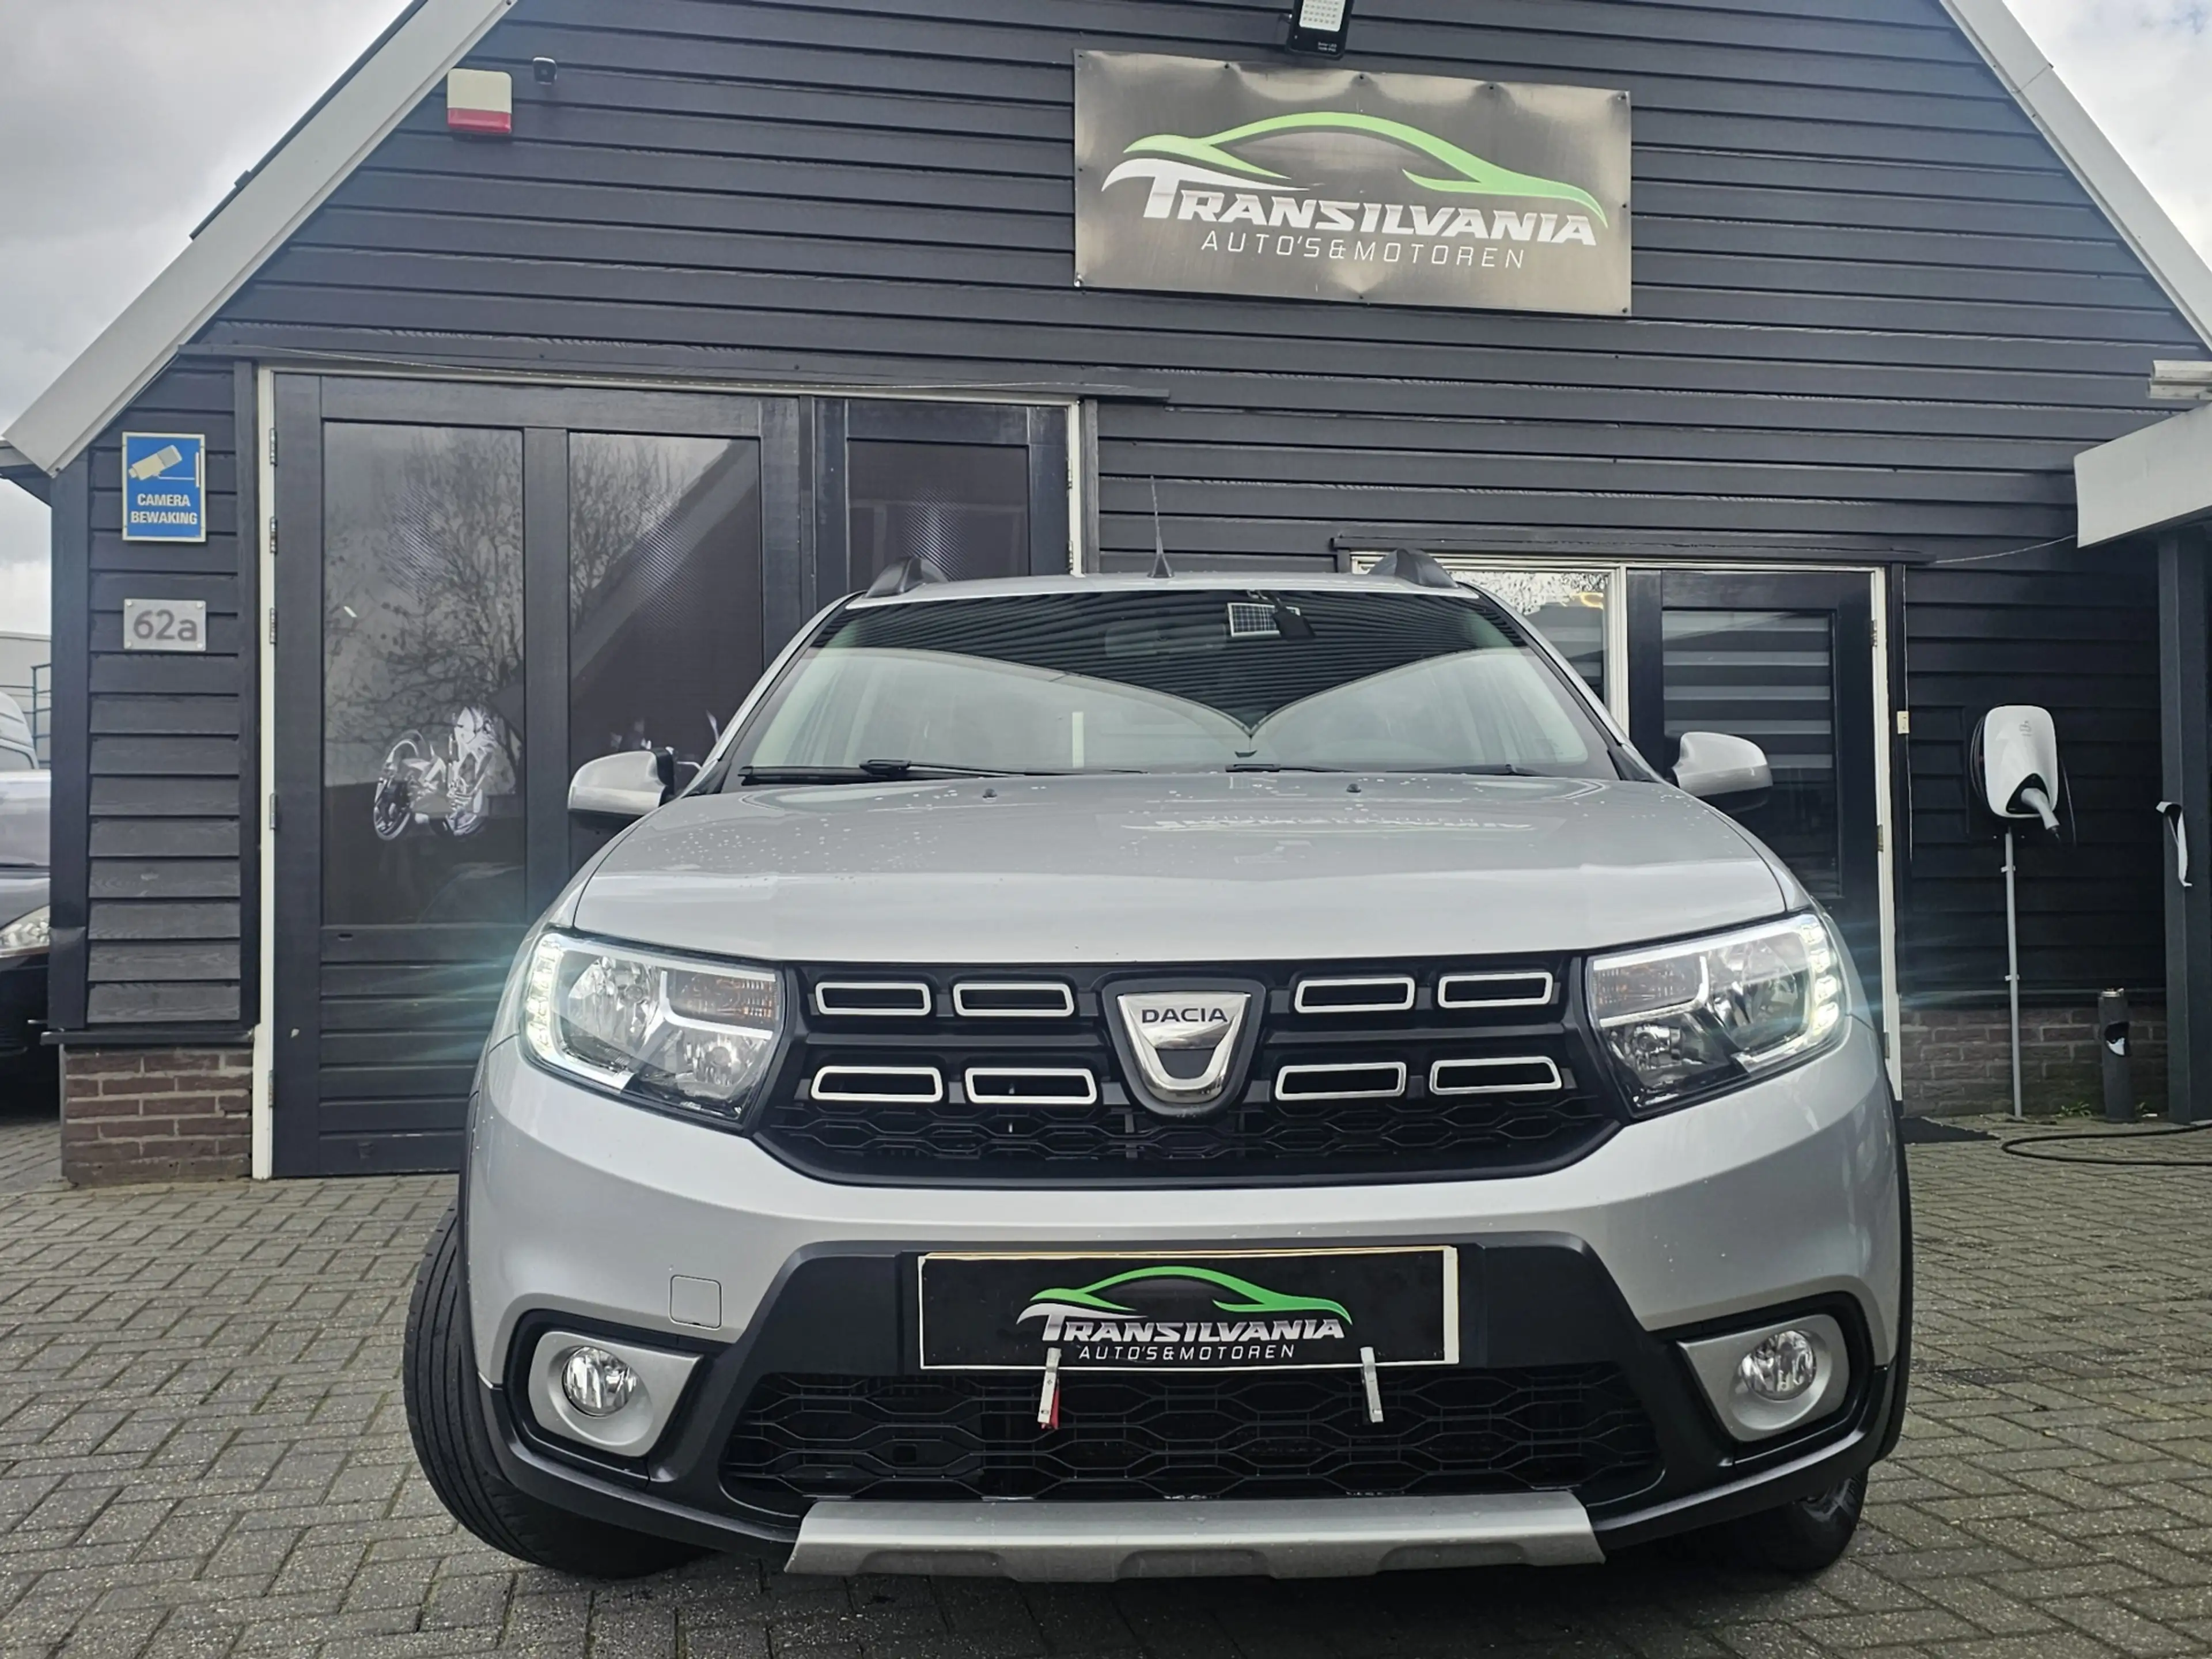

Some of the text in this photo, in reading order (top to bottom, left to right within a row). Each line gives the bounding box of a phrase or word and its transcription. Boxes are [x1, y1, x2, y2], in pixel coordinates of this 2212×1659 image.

[1101, 158, 1597, 246] TRANSILVANIA
[1201, 230, 1525, 269] AUTO'S&MOTOREN
[137, 493, 191, 507] CAMERA
[130, 510, 198, 525] BEWAKING
[132, 608, 198, 642] 62a
[1141, 1007, 1228, 1024] DACIA
[1016, 1302, 1346, 1343] TRANSILVANIA
[1078, 1343, 1296, 1361] AUTO'S&MOTOREN
